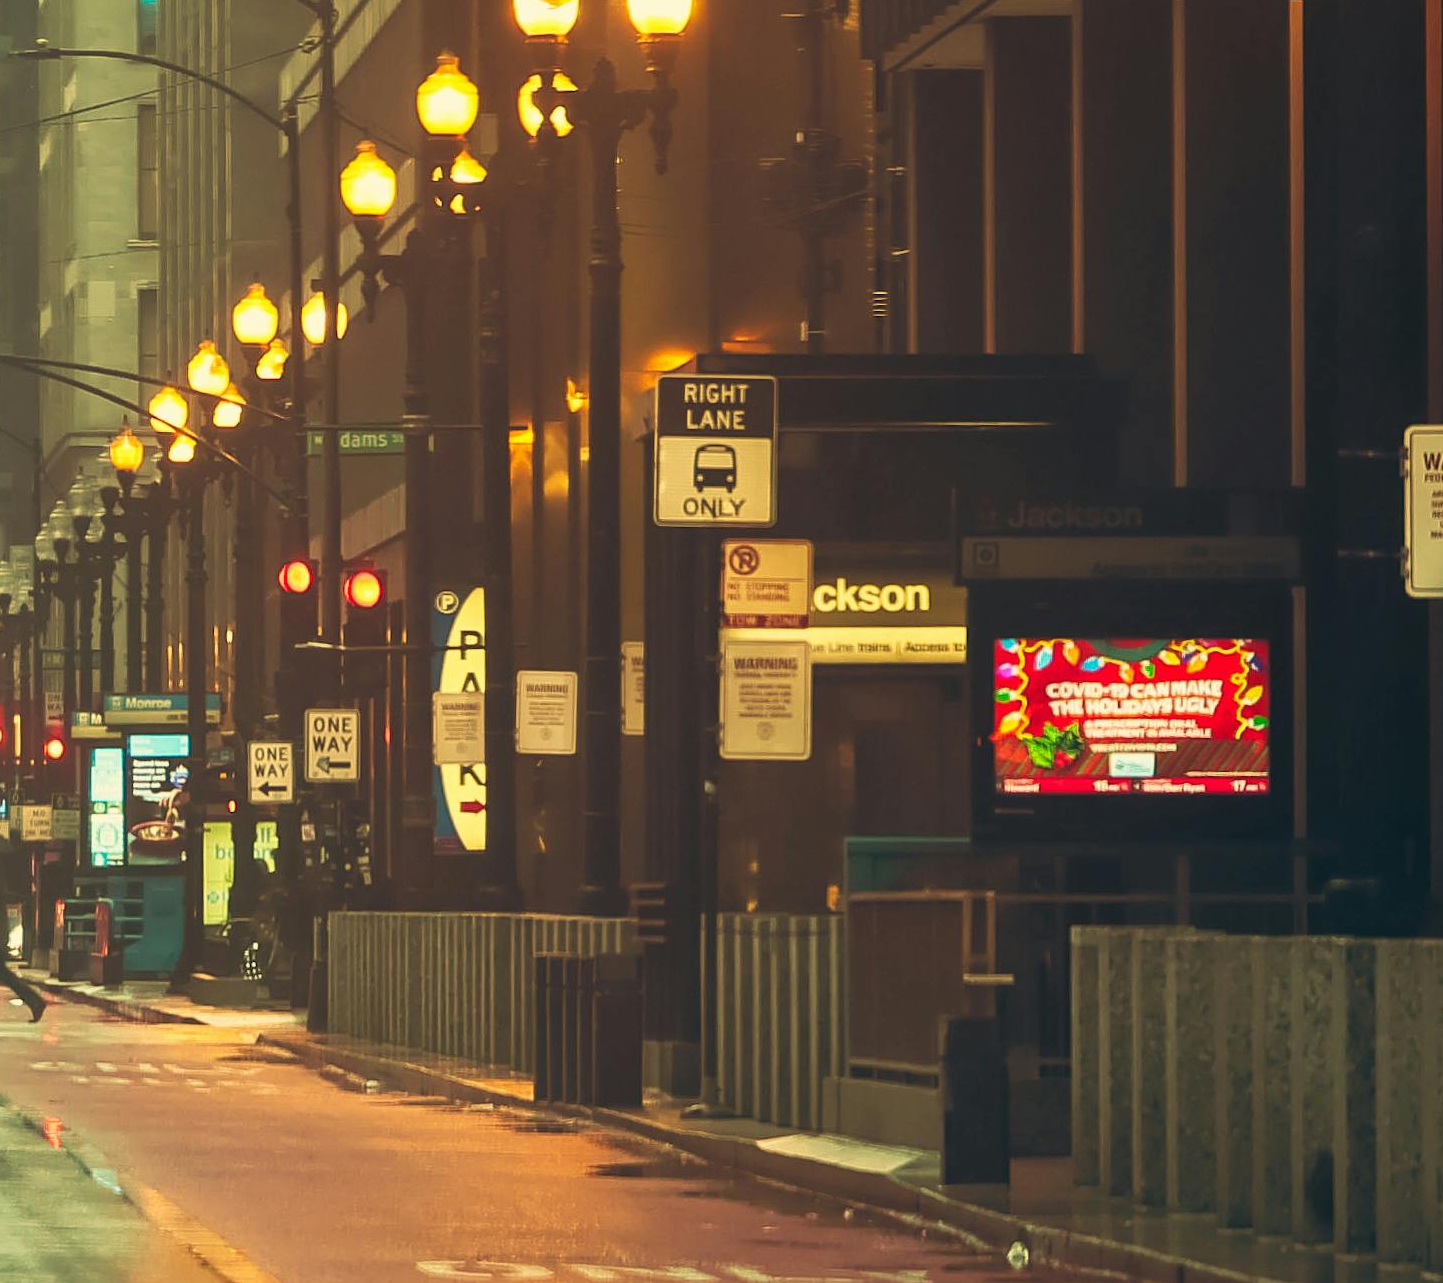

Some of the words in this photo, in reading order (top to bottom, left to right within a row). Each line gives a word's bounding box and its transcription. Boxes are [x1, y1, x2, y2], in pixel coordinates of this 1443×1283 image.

[684, 383, 748, 404] RIGHT
[687, 409, 746, 430] LANE
[340, 430, 388, 448] dams
[683, 497, 746, 518] ONLY
[1008, 501, 1143, 528] Jackson
[812, 578, 931, 613] ckson
[734, 657, 798, 671] WARNING
[526, 683, 569, 694] WARNING
[1046, 681, 1129, 699] COVID-19
[1130, 680, 1171, 699] CAN
[1171, 679, 1223, 698] MAKE
[125, 697, 172, 710] Monroe
[460, 630, 487, 786] PAK
[1048, 699, 1085, 716] THE
[1086, 698, 1173, 716] HOLIDAYS
[1174, 697, 1220, 716] UGLY
[314, 717, 352, 734] ONE
[313, 736, 353, 753] WAY
[255, 747, 289, 762] ONE
[255, 764, 289, 778] WAY
